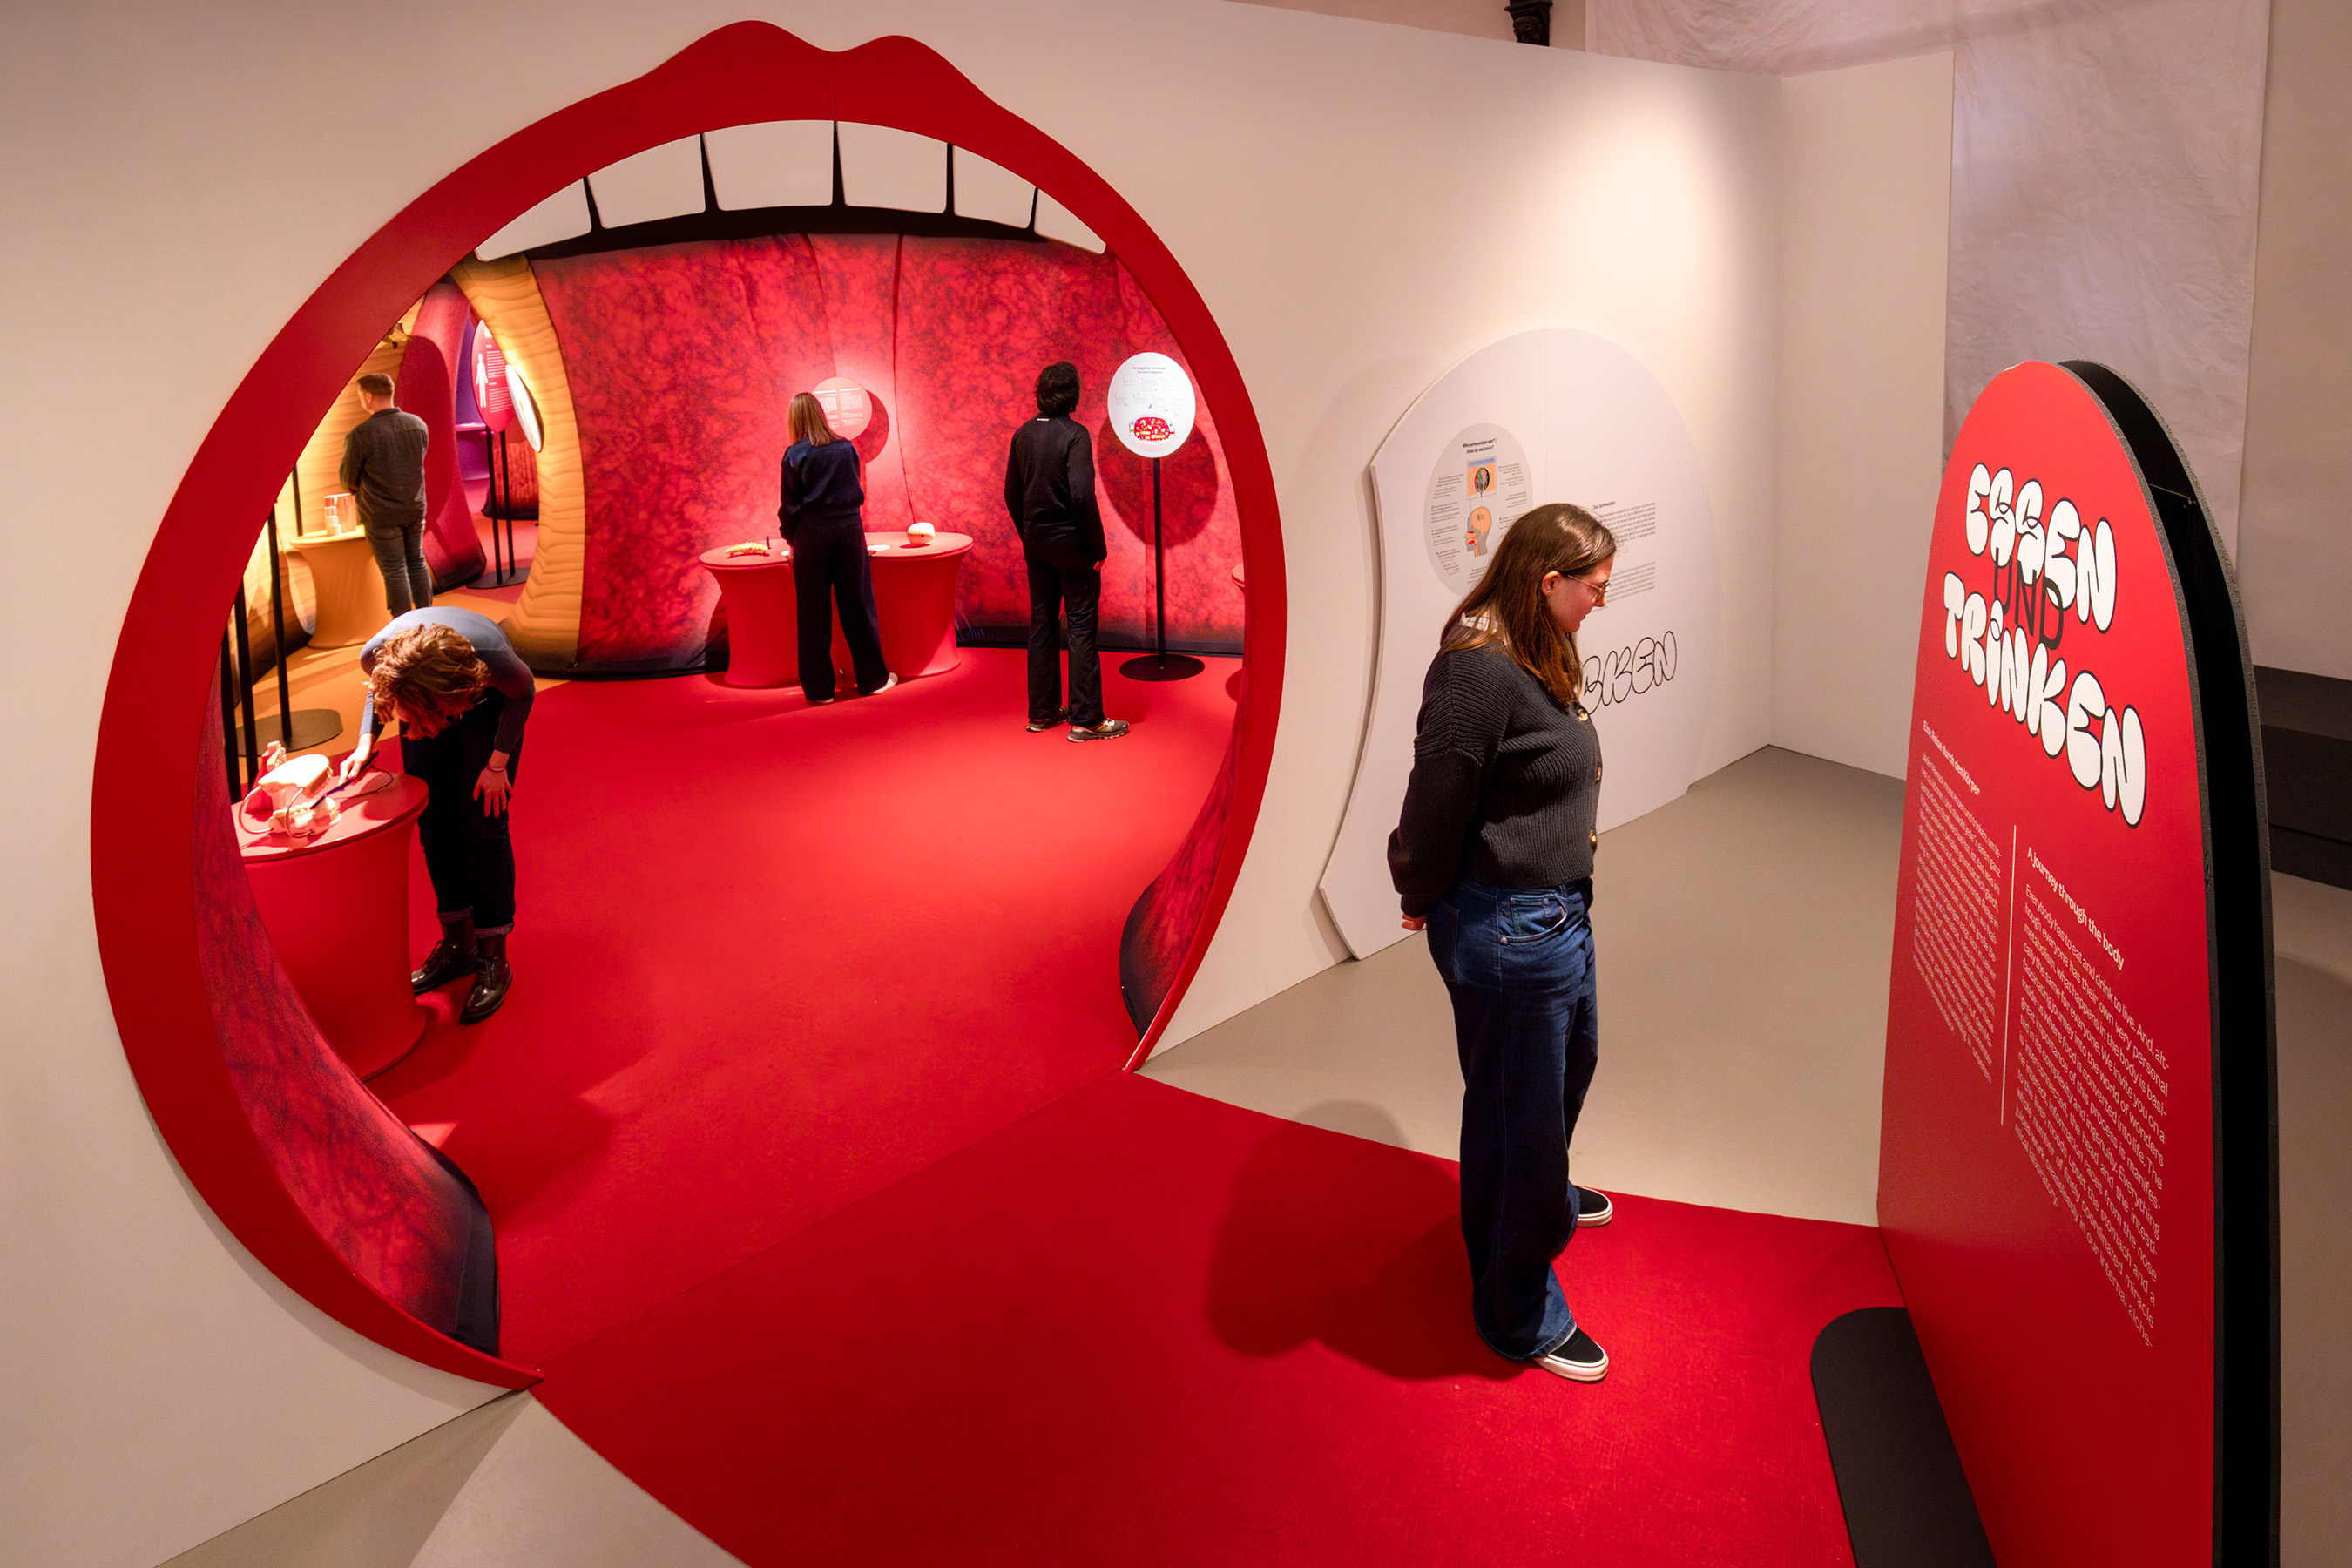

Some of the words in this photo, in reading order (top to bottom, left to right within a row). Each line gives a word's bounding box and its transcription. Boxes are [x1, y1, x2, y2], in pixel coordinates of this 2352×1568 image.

[1966, 463, 2117, 632] ESSEN
[1994, 547, 2064, 650] UND
[1942, 745, 1955, 767] durch
[1943, 571, 2147, 829] TRINKEN
[2027, 846, 2033, 862] A
[2032, 852, 2058, 892] journey
[2058, 883, 2087, 925] through
[2088, 918, 2102, 943] the
[2102, 933, 2124, 970] body
[2095, 974, 2113, 1003] drink
[2113, 996, 2122, 1013] to
[2121, 1004, 2136, 1031] live.
[2154, 1049, 2169, 1070] alt-
[2099, 1002, 2113, 1026] own
[2114, 1022, 2132, 1051] very
[2132, 1045, 2168, 1096] personal
[2099, 1021, 2106, 1040] in
[2106, 1032, 2119, 1057] the
[2119, 1048, 2139, 1084] body
[2139, 1073, 2146, 1093] is
[2146, 1084, 2166, 1116] basi-
[2082, 1069, 2117, 1123] converted
[2117, 1115, 2132, 1145] into
[2132, 1137, 2146, 1166] life.
[2146, 1156, 2162, 1190] The
[2087, 1051, 2099, 1074] the
[2099, 1070, 2119, 1104] world
[2119, 1099, 2129, 1116] of
[2129, 1112, 2163, 1166] wonders
[2101, 1045, 2113, 1071] We
[2112, 1063, 2132, 1098] invite
[2132, 1093, 2148, 1119] you
[2147, 1114, 2159, 1135] on
[2159, 1130, 2165, 1144] a
[2082, 1131, 2099, 1165] head
[2099, 1163, 2114, 1189] and
[2115, 1186, 2129, 1213] the
[2131, 1207, 2158, 1254] intesti-
[2090, 1102, 2118, 1148] process
[2119, 1141, 2126, 1160] is
[2126, 1158, 2160, 1209] manifes-
[2119, 1165, 2159, 1240] Everything
[2081, 1200, 2123, 1274] coordinated
[2125, 1274, 2153, 1328] miracle
[2084, 1159, 2103, 1194] races
[2104, 1189, 2122, 1225] from
[2123, 1221, 2136, 1248] the
[2137, 1247, 2157, 1282] nose
[2087, 1186, 2099, 1211] the
[2100, 1209, 2132, 1266] stomach
[2132, 1264, 2148, 1293] and
[2149, 1291, 2155, 1307] a
[2079, 1215, 2086, 1234] in
[2086, 1232, 2099, 1254] our
[2099, 1251, 2127, 1306] internal
[2128, 1304, 2152, 1346] alche-
